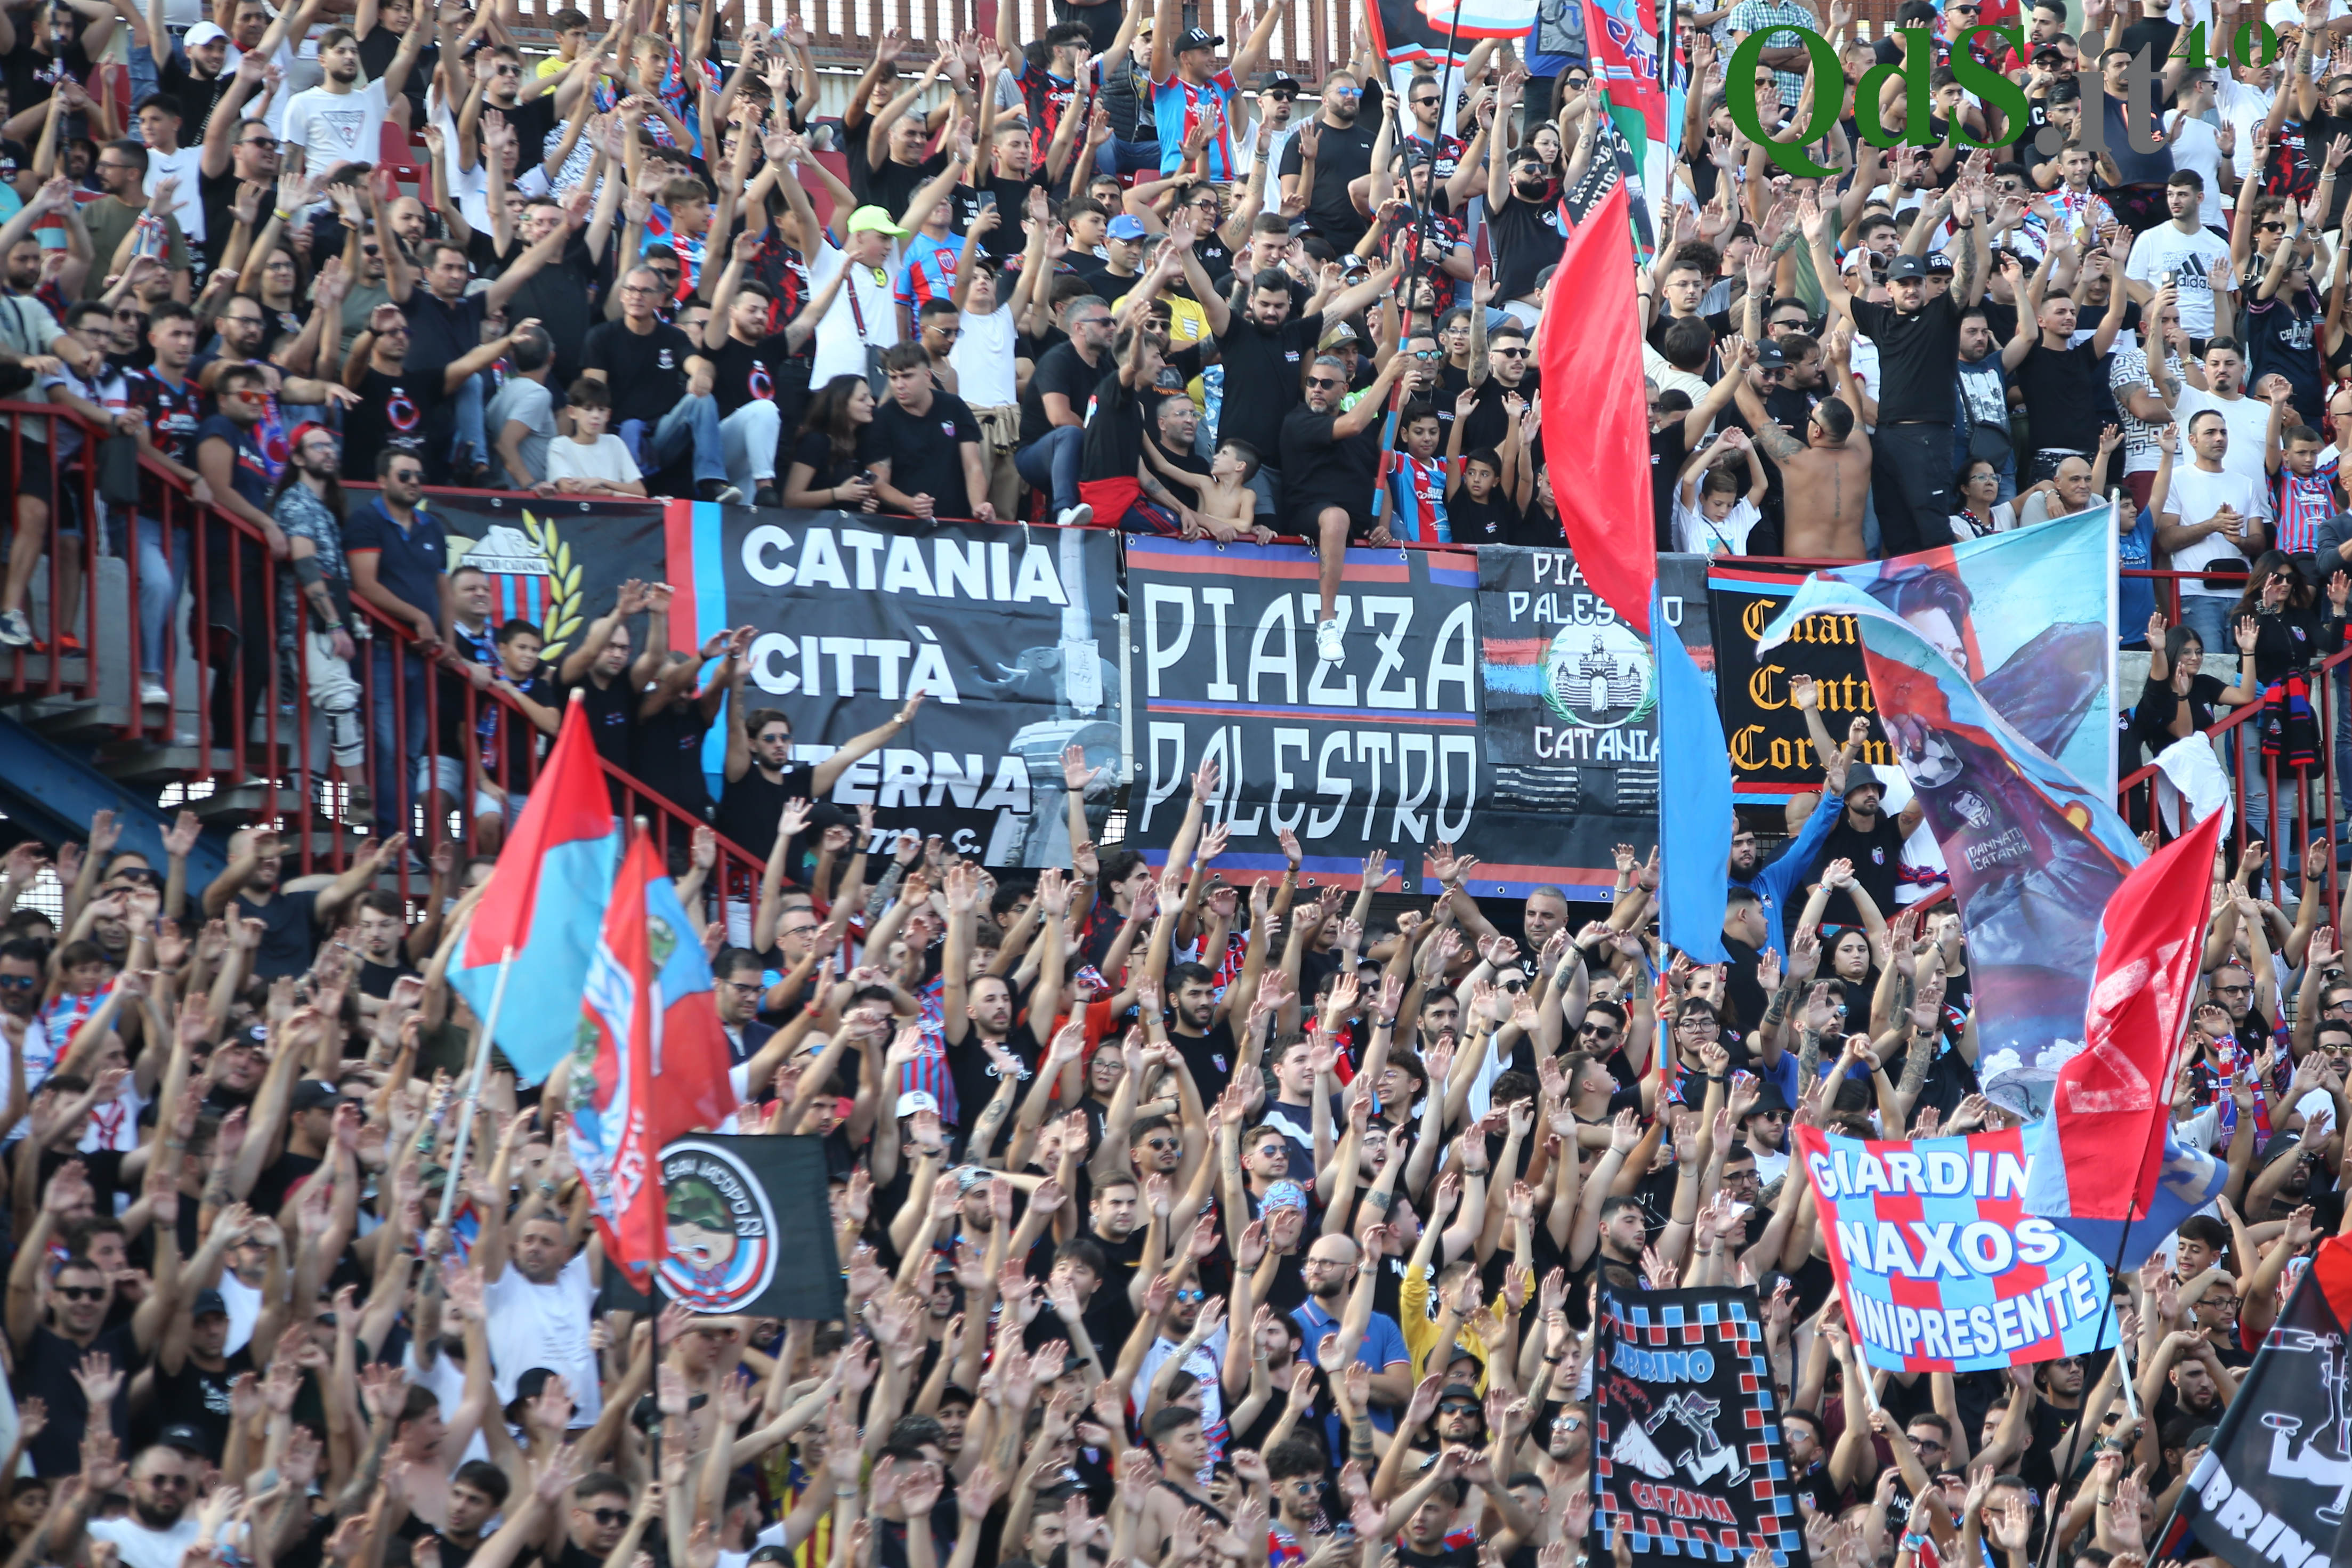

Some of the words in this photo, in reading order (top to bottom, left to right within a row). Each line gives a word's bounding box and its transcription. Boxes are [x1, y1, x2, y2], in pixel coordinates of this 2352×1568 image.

[741, 524, 1070, 605] CATANIA
[749, 625, 961, 706] CITTÀ
[1143, 583, 1476, 713] PIAZZA
[1139, 721, 1477, 844] PALESTRO
[1968, 827, 2022, 858] DANNATI
[1973, 841, 2030, 870] CATANIA
[1809, 1150, 2035, 1199] GIARDIN
[1835, 1218, 2061, 1278] NAXOS
[1630, 1480, 1738, 1525] CATANIA
